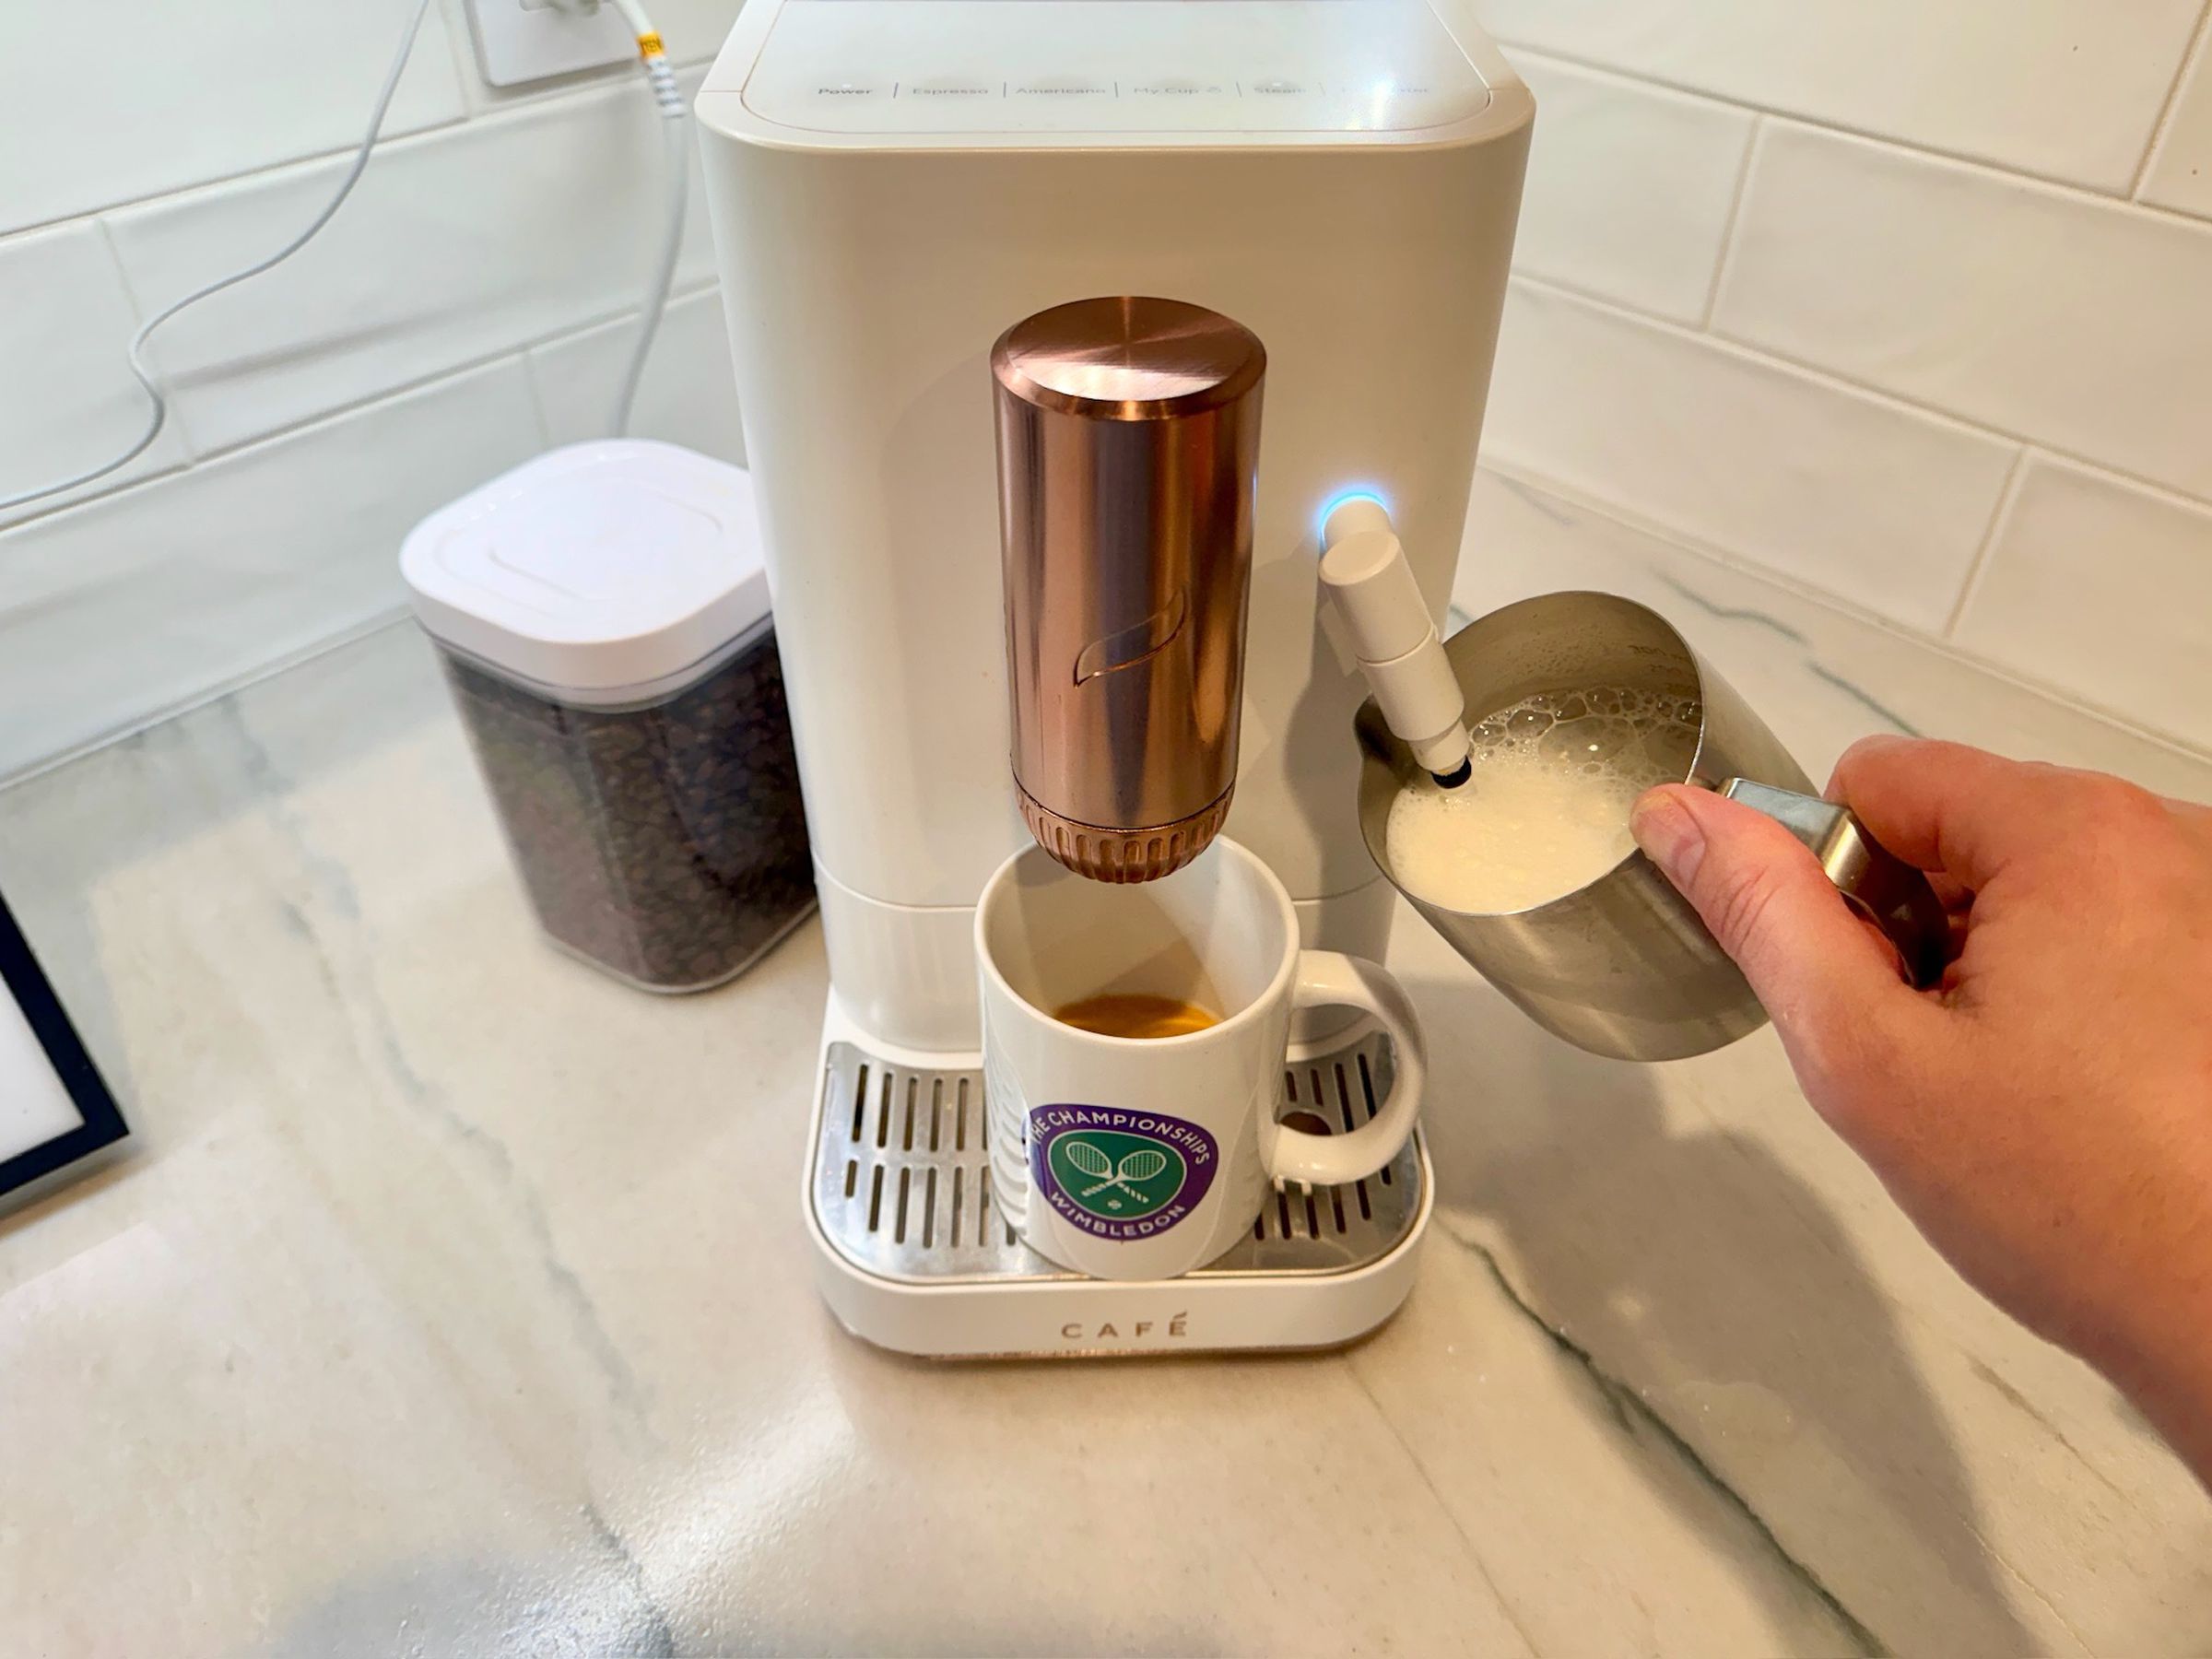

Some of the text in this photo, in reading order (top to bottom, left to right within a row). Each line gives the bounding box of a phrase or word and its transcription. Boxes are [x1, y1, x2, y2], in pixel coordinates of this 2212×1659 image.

[912, 88, 989, 96] Espresso
[1015, 87, 1106, 95] Americano
[1048, 1111, 1210, 1165] CHAMPIONSHIPS
[1051, 1191, 1185, 1237] WIMBLEDON
[1061, 1311, 1188, 1338] CAFÉ
